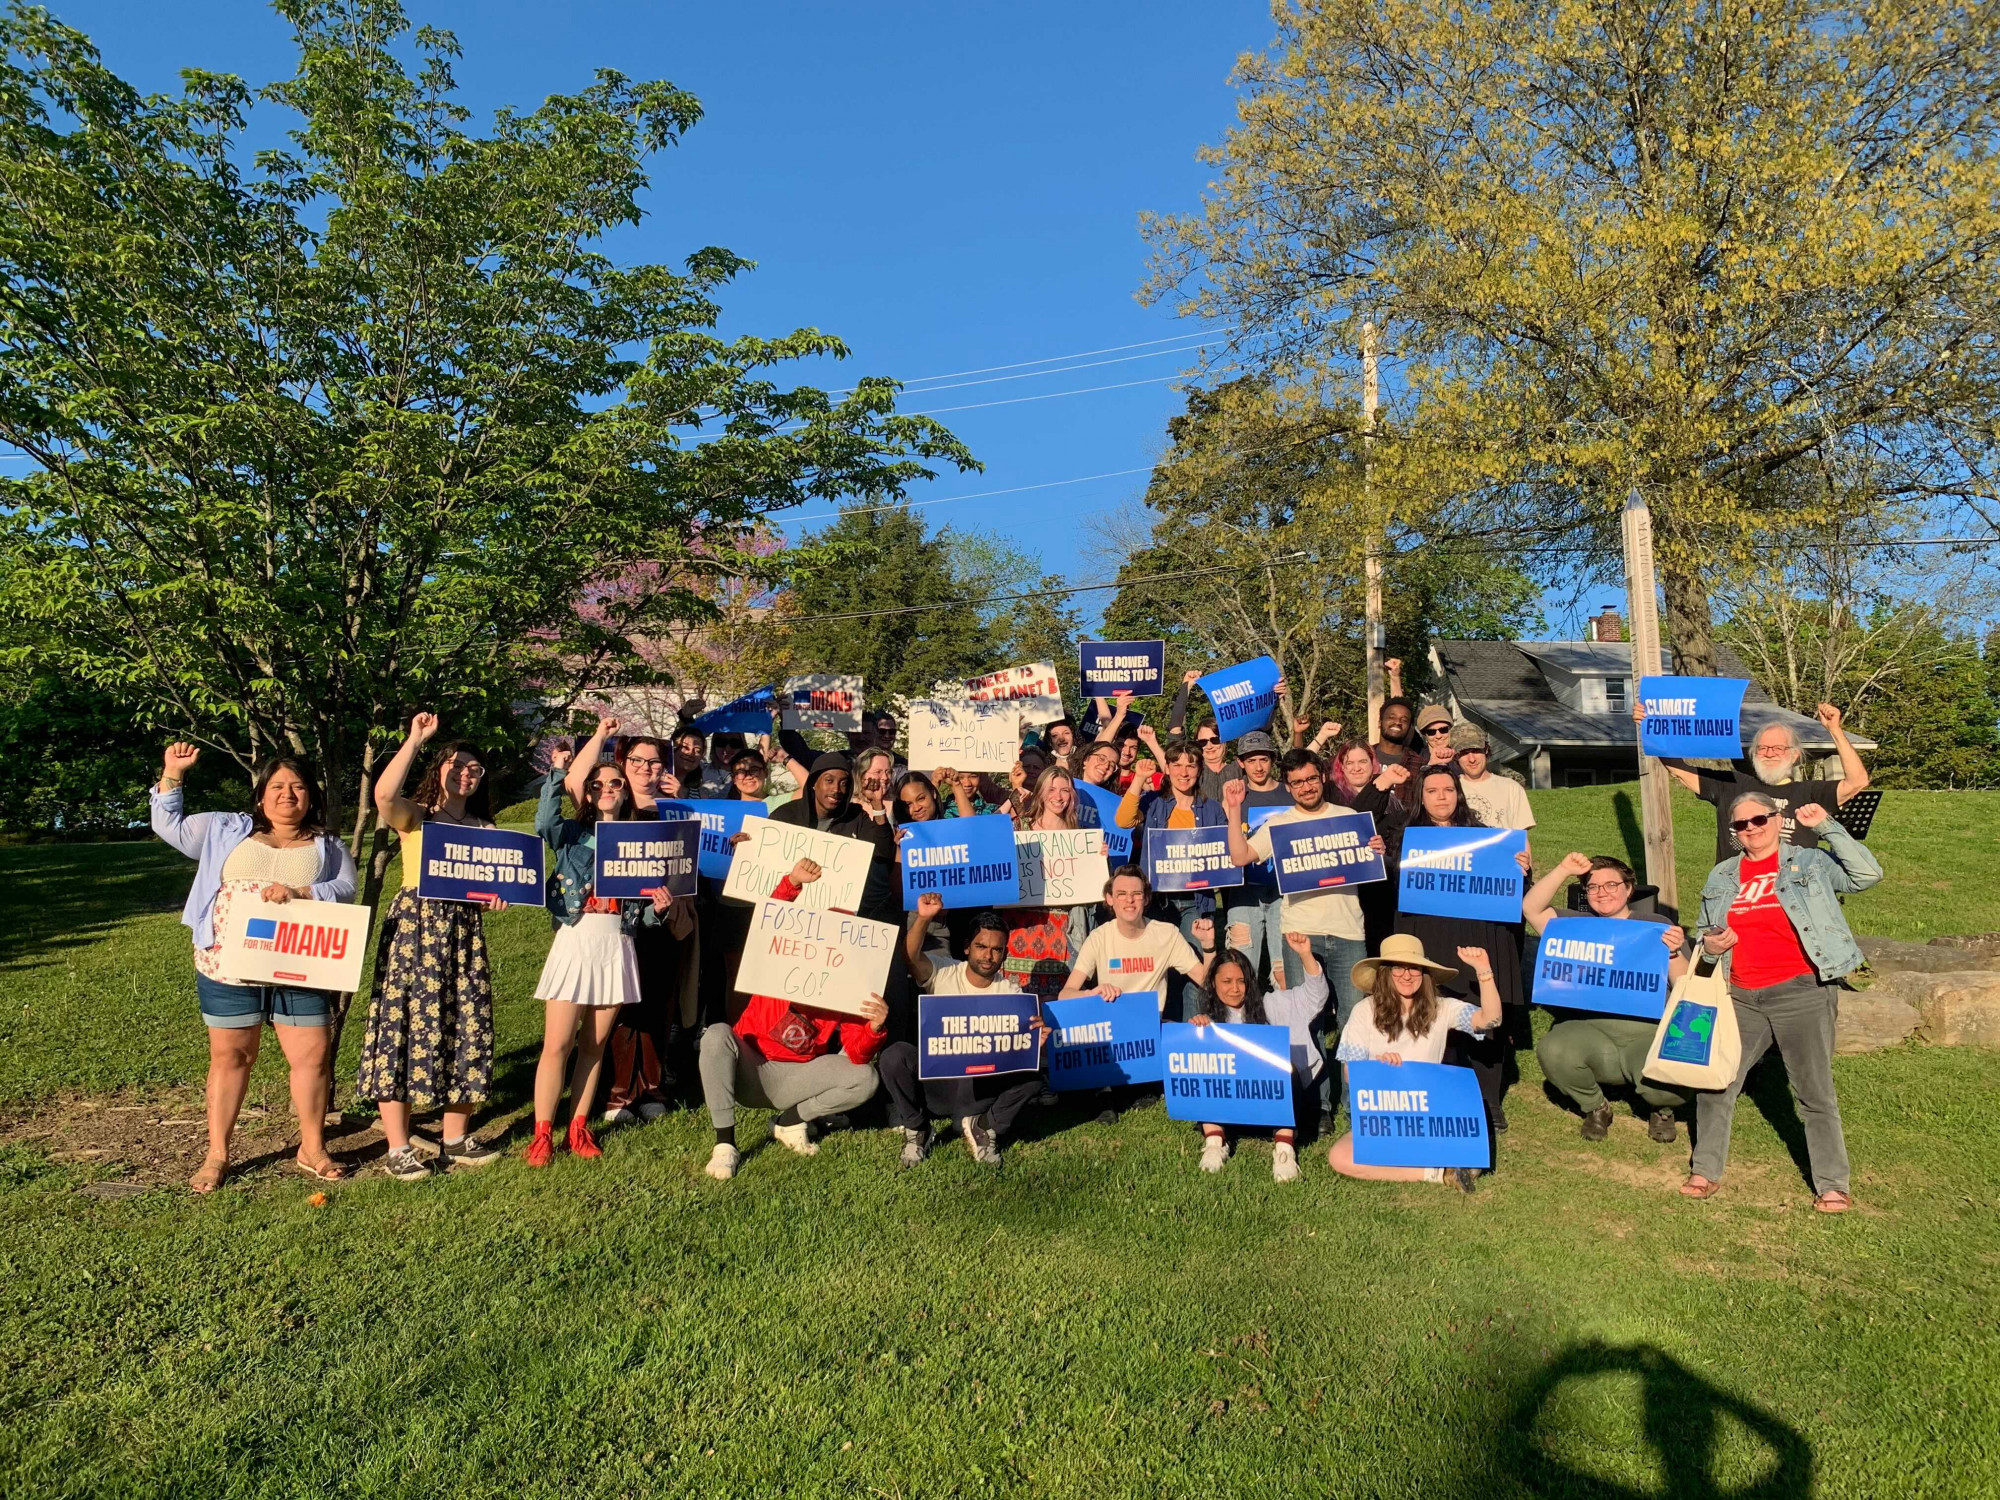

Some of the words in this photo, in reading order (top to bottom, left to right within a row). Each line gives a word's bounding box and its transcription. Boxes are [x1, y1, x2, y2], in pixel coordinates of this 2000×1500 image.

[1095, 656, 1114, 669] THE
[1114, 655, 1150, 669] POWER
[966, 671, 1010, 691] THERE
[1020, 666, 1033, 679] IS
[1085, 669, 1131, 682] BELONGS
[1131, 669, 1144, 681] TO
[1145, 668, 1158, 680] US
[992, 679, 1043, 701] PLANET
[1048, 677, 1058, 695] B
[1211, 679, 1255, 705] CLIMATE
[810, 691, 853, 712] MANY
[1218, 705, 1238, 722] FOR
[1237, 698, 1254, 716] THE
[1645, 698, 1697, 716] CLIMATE
[960, 719, 985, 732] NOT
[1646, 719, 1669, 735] FOR
[1671, 719, 1692, 736] THE
[1694, 719, 1734, 736] MANY
[939, 737, 961, 748] HOT
[964, 735, 1017, 763] PLANET
[444, 842, 470, 861] THE
[472, 846, 523, 866] POWER
[617, 841, 643, 859] THE
[645, 840, 684, 858] POWER
[702, 832, 720, 853] HE
[757, 826, 851, 873] PUBLIC
[1016, 831, 1098, 860] NORANCE
[1103, 831, 1128, 853] ANY
[1165, 844, 1188, 858] THE
[1188, 841, 1226, 857] POWER
[1290, 839, 1314, 855] THE
[1314, 830, 1360, 851] POWER
[603, 860, 666, 877] BELONGS
[667, 859, 679, 876] TO
[679, 857, 693, 874] US
[907, 844, 969, 868] CLIMATE
[1155, 859, 1205, 874] BELONGS
[1206, 857, 1220, 871] TO
[1221, 856, 1235, 869] US
[1281, 852, 1339, 874] BELONGS
[1340, 849, 1356, 865] TO
[1356, 846, 1375, 862] US
[1407, 849, 1473, 871] CLIMATE
[428, 859, 495, 882] BELONGS
[497, 866, 515, 883] TO
[517, 867, 537, 885] US
[909, 869, 937, 890] FOR
[939, 866, 966, 887] THE
[968, 862, 1012, 885] MANY
[1020, 862, 1034, 878] IS
[1039, 857, 1078, 881] NOT
[1406, 870, 1435, 891] FOR
[1438, 873, 1465, 893] THE
[1468, 875, 1516, 897] MANY
[760, 902, 824, 941] FOSSIL
[839, 920, 889, 950] FUELS
[243, 938, 258, 950] FOR
[259, 940, 274, 952] THE
[274, 920, 349, 959] MANY
[768, 935, 817, 960] NEED
[825, 946, 845, 968] TO
[1544, 937, 1615, 965] CLIMATE
[1122, 957, 1154, 974] MANY
[1541, 959, 1573, 982] FOR
[1576, 964, 1606, 987] THE
[1608, 969, 1660, 993] MANY
[783, 966, 830, 998] GO!
[941, 1016, 968, 1035] THE
[969, 1014, 1019, 1034] POWER
[1052, 1021, 1113, 1049] CLIMATE
[927, 1035, 992, 1056] BELONGS
[994, 1034, 1010, 1052] TO
[1012, 1032, 1032, 1050] US
[1054, 1048, 1084, 1071] FOR
[1085, 1043, 1110, 1065] THE
[1113, 1038, 1155, 1062] MANY
[1168, 1052, 1236, 1075] CLIMATE
[1171, 1077, 1201, 1098] FOR
[1202, 1078, 1231, 1099] THE
[1235, 1079, 1284, 1100] MANY
[1356, 1089, 1429, 1112] CLIMATE
[1359, 1115, 1391, 1137] FOR
[1394, 1115, 1425, 1137] THE
[1428, 1116, 1480, 1138] MANY
